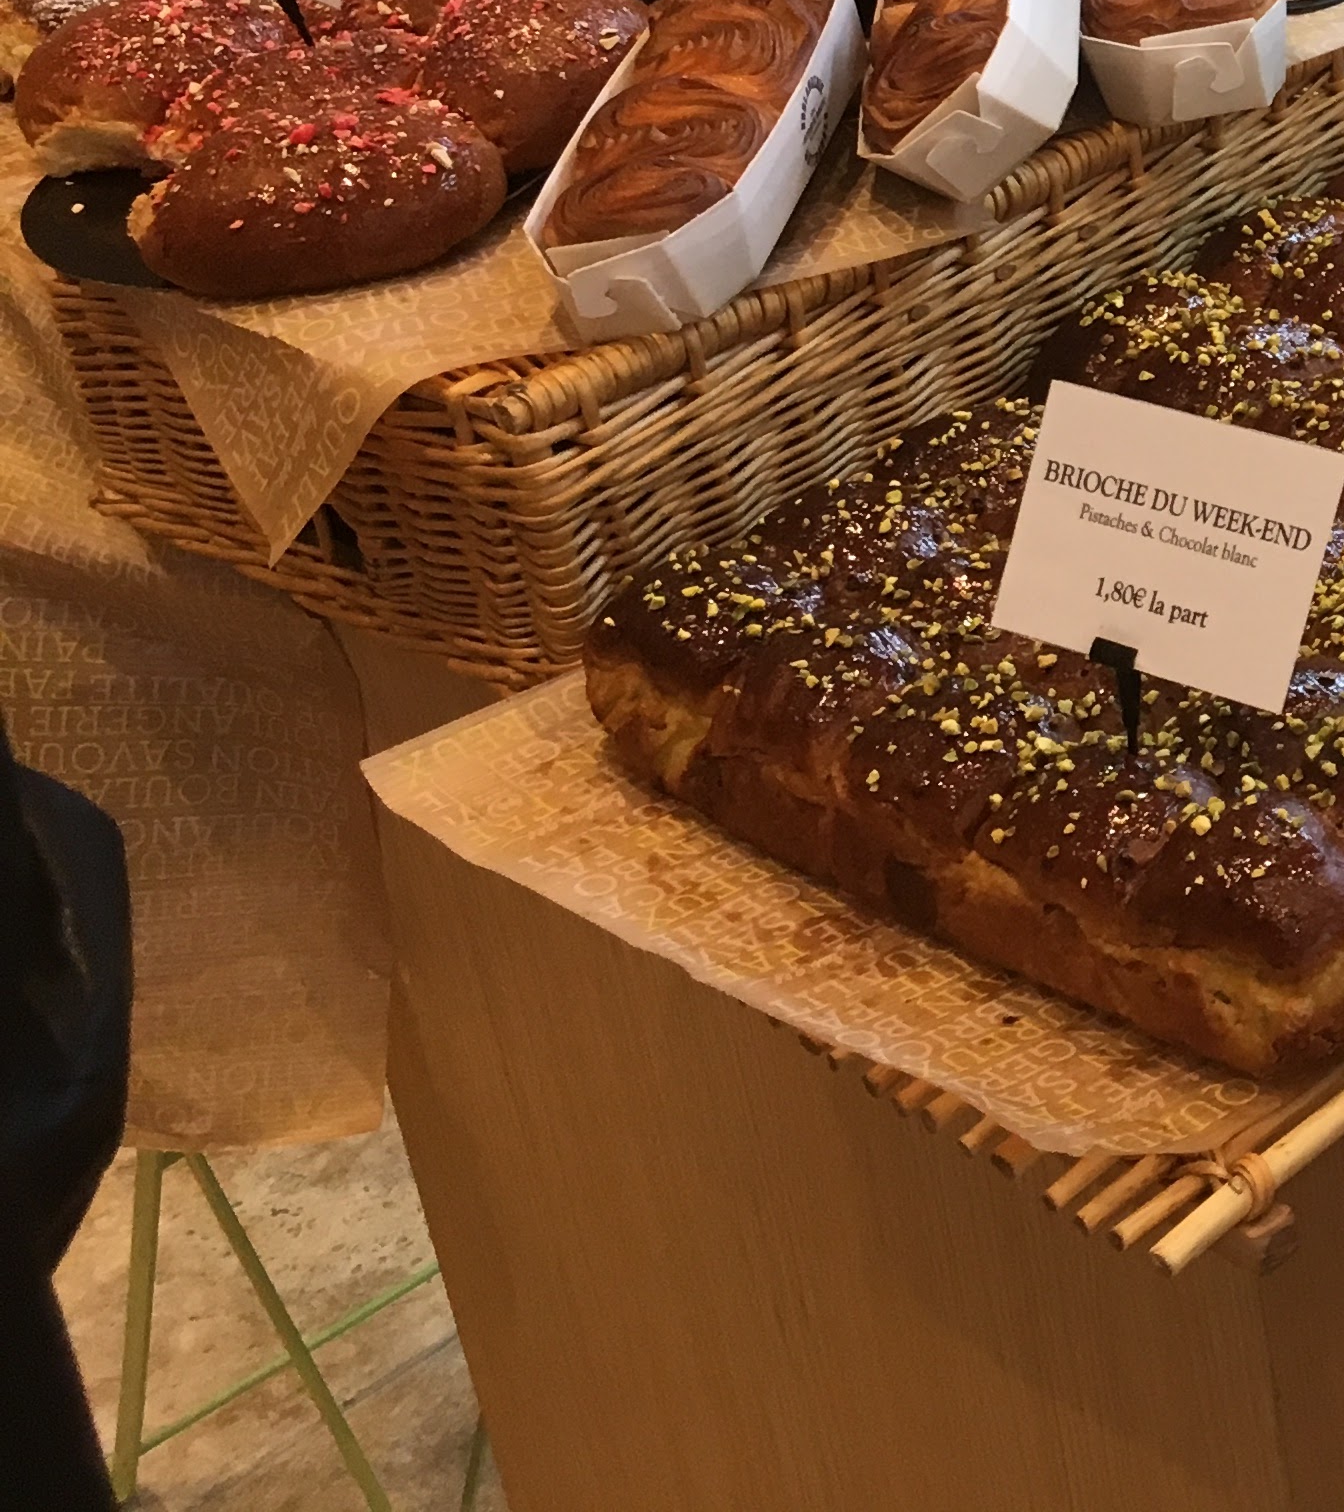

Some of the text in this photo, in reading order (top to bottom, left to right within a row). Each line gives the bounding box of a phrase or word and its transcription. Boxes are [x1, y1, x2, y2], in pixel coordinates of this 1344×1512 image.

[1044, 459, 1312, 551] BRIOCHE DU WEEK-END
[1080, 503, 1258, 568] Pistaches & Chocolat blanc
[1096, 577, 1209, 628] 1,80€ la part
